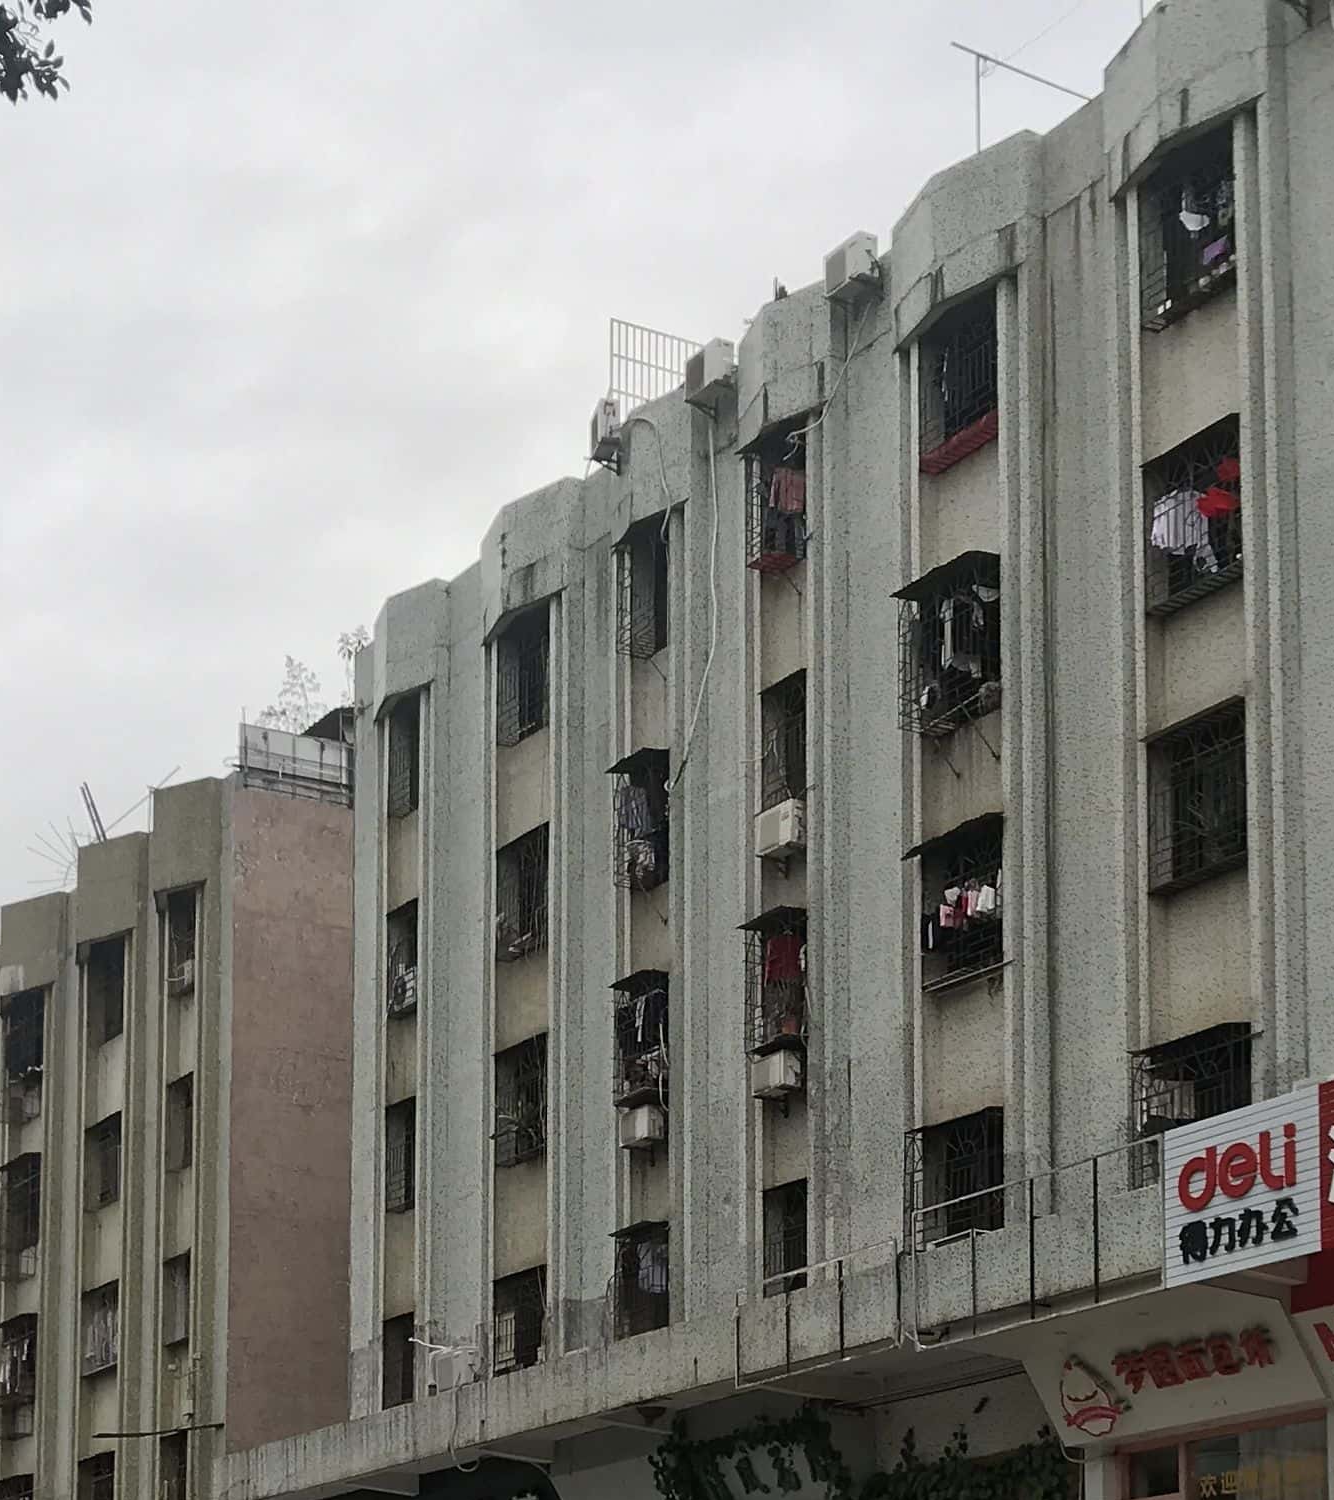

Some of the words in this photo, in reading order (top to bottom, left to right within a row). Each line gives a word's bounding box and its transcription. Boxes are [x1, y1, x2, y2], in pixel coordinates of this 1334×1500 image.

[1178, 1122, 1297, 1212] deli
[1179, 1197, 1299, 1265] 得力办公
